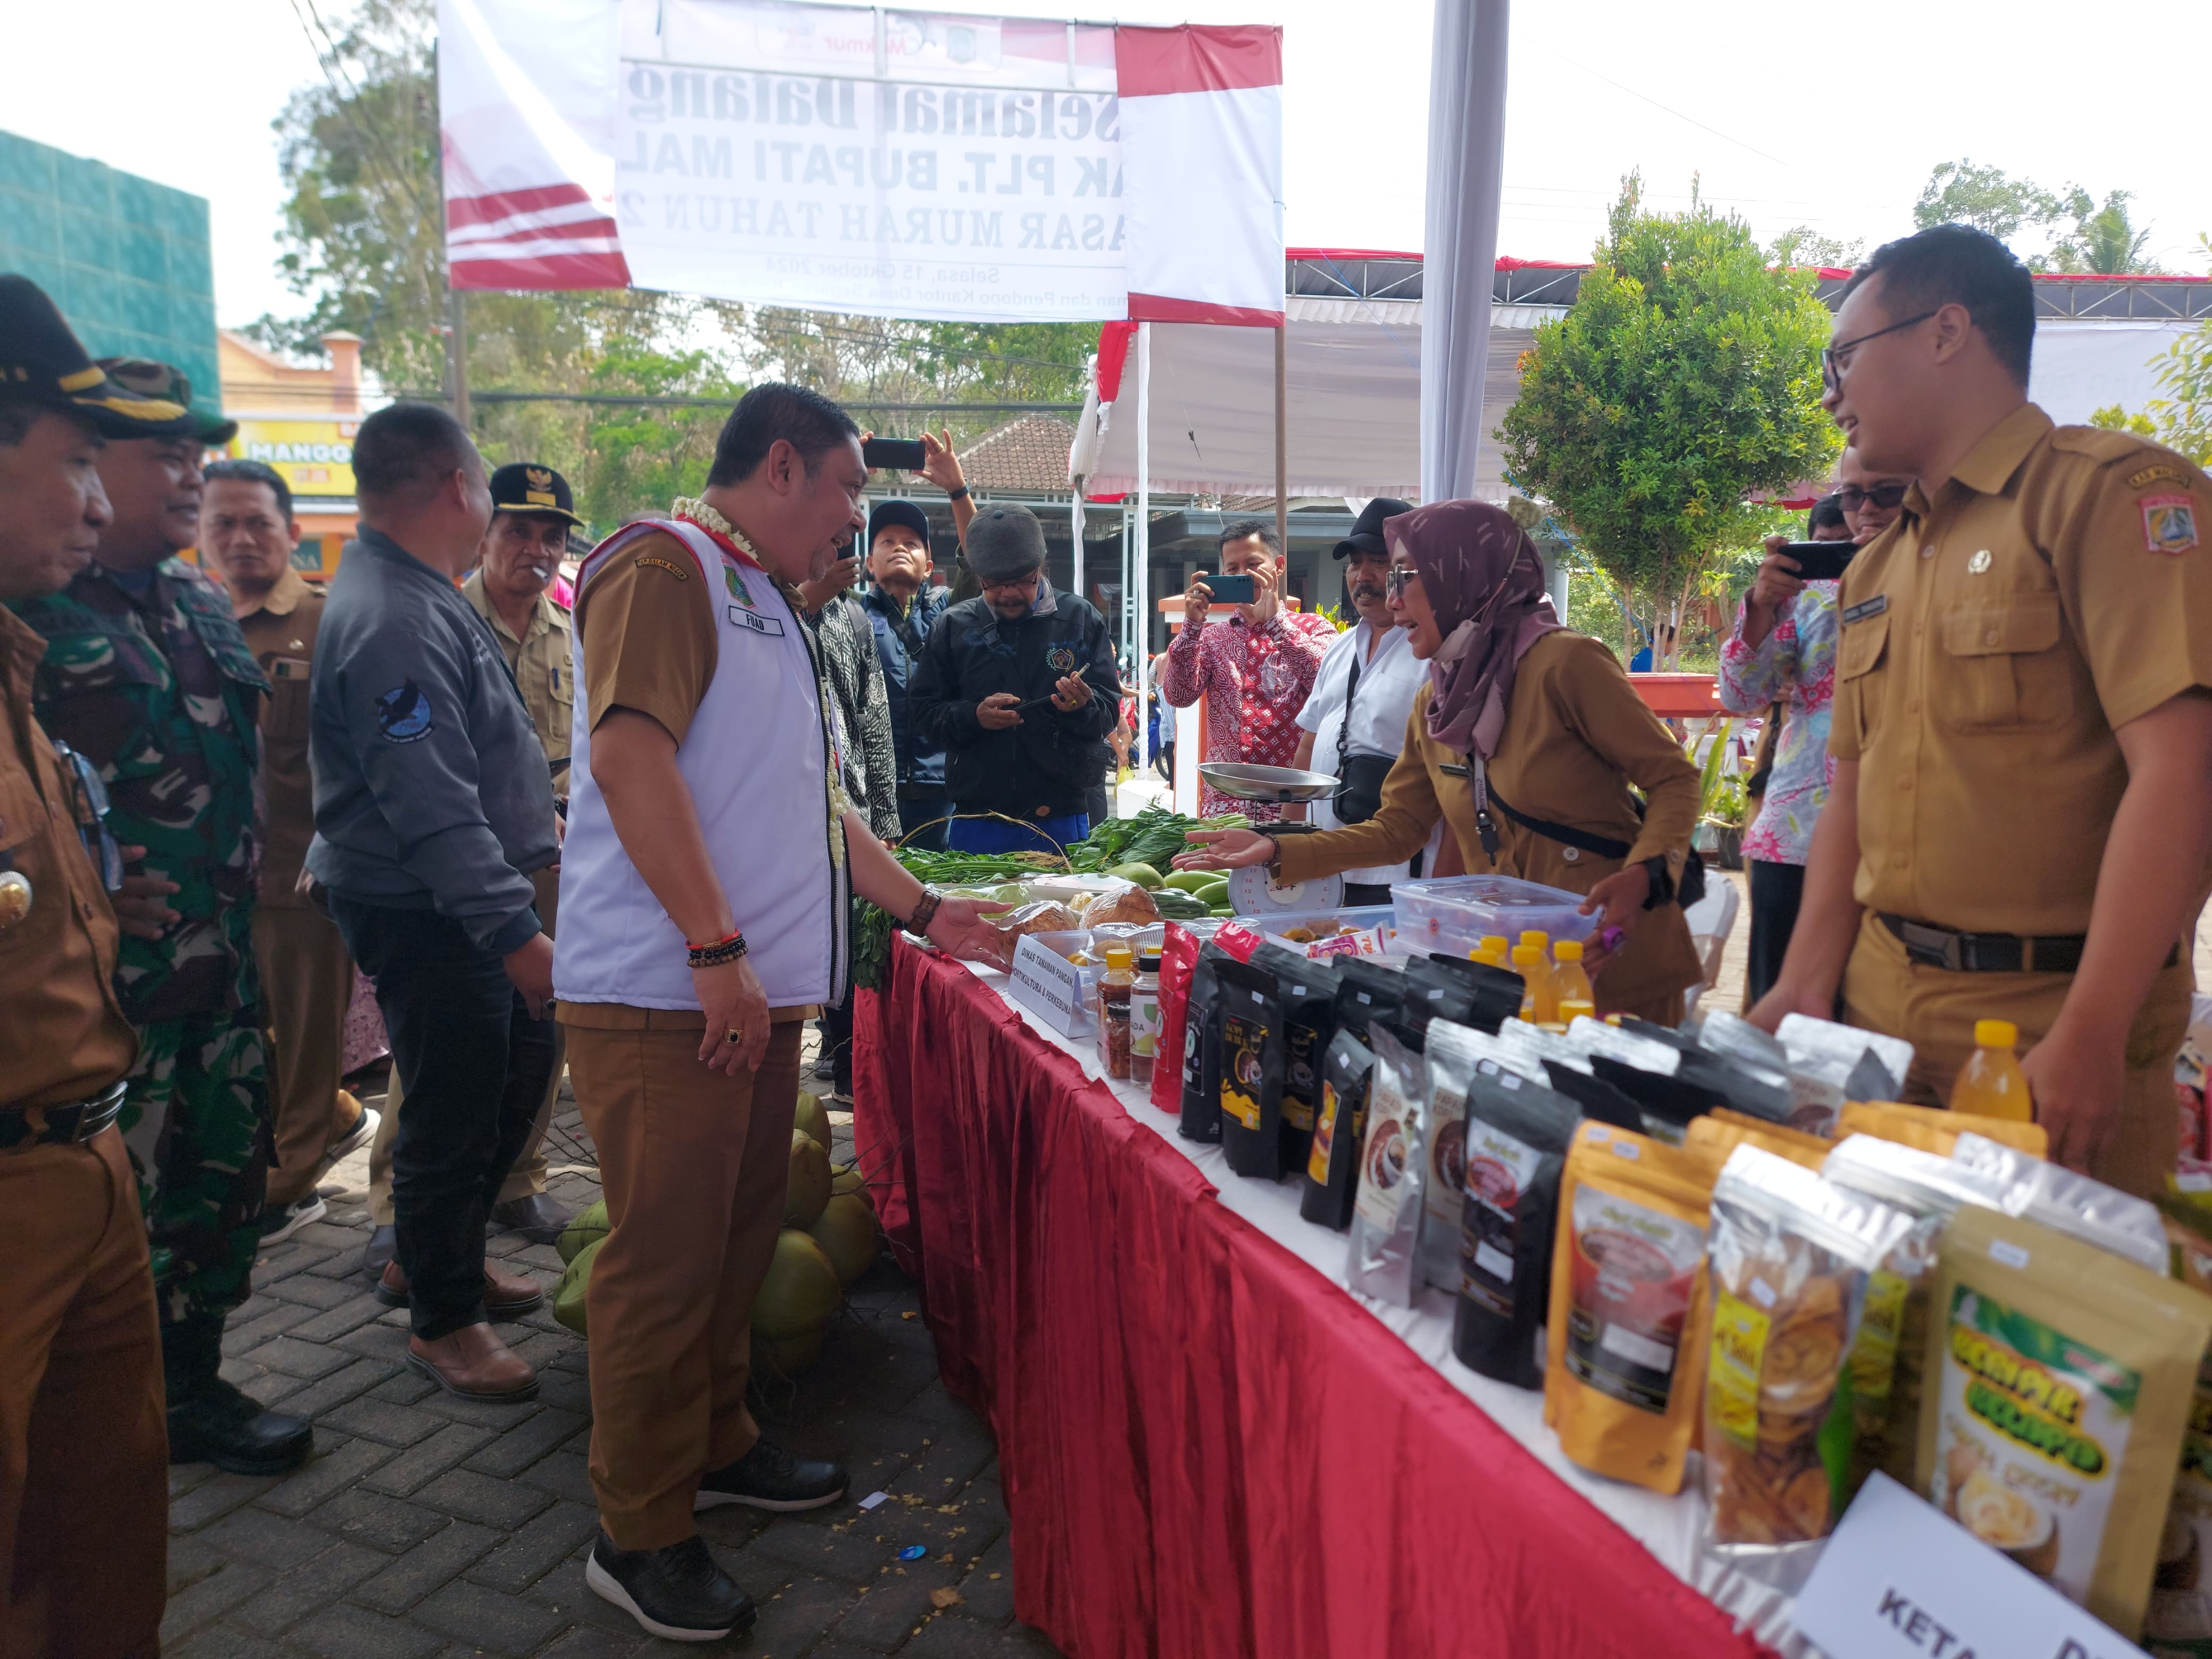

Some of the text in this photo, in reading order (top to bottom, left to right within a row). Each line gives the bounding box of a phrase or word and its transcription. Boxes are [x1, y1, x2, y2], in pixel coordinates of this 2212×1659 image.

[745, 613, 765, 631] FUAD
[1021, 948, 1074, 990] DINAS TANAMAN PANGAN,
[1042, 987, 1046, 997] &
